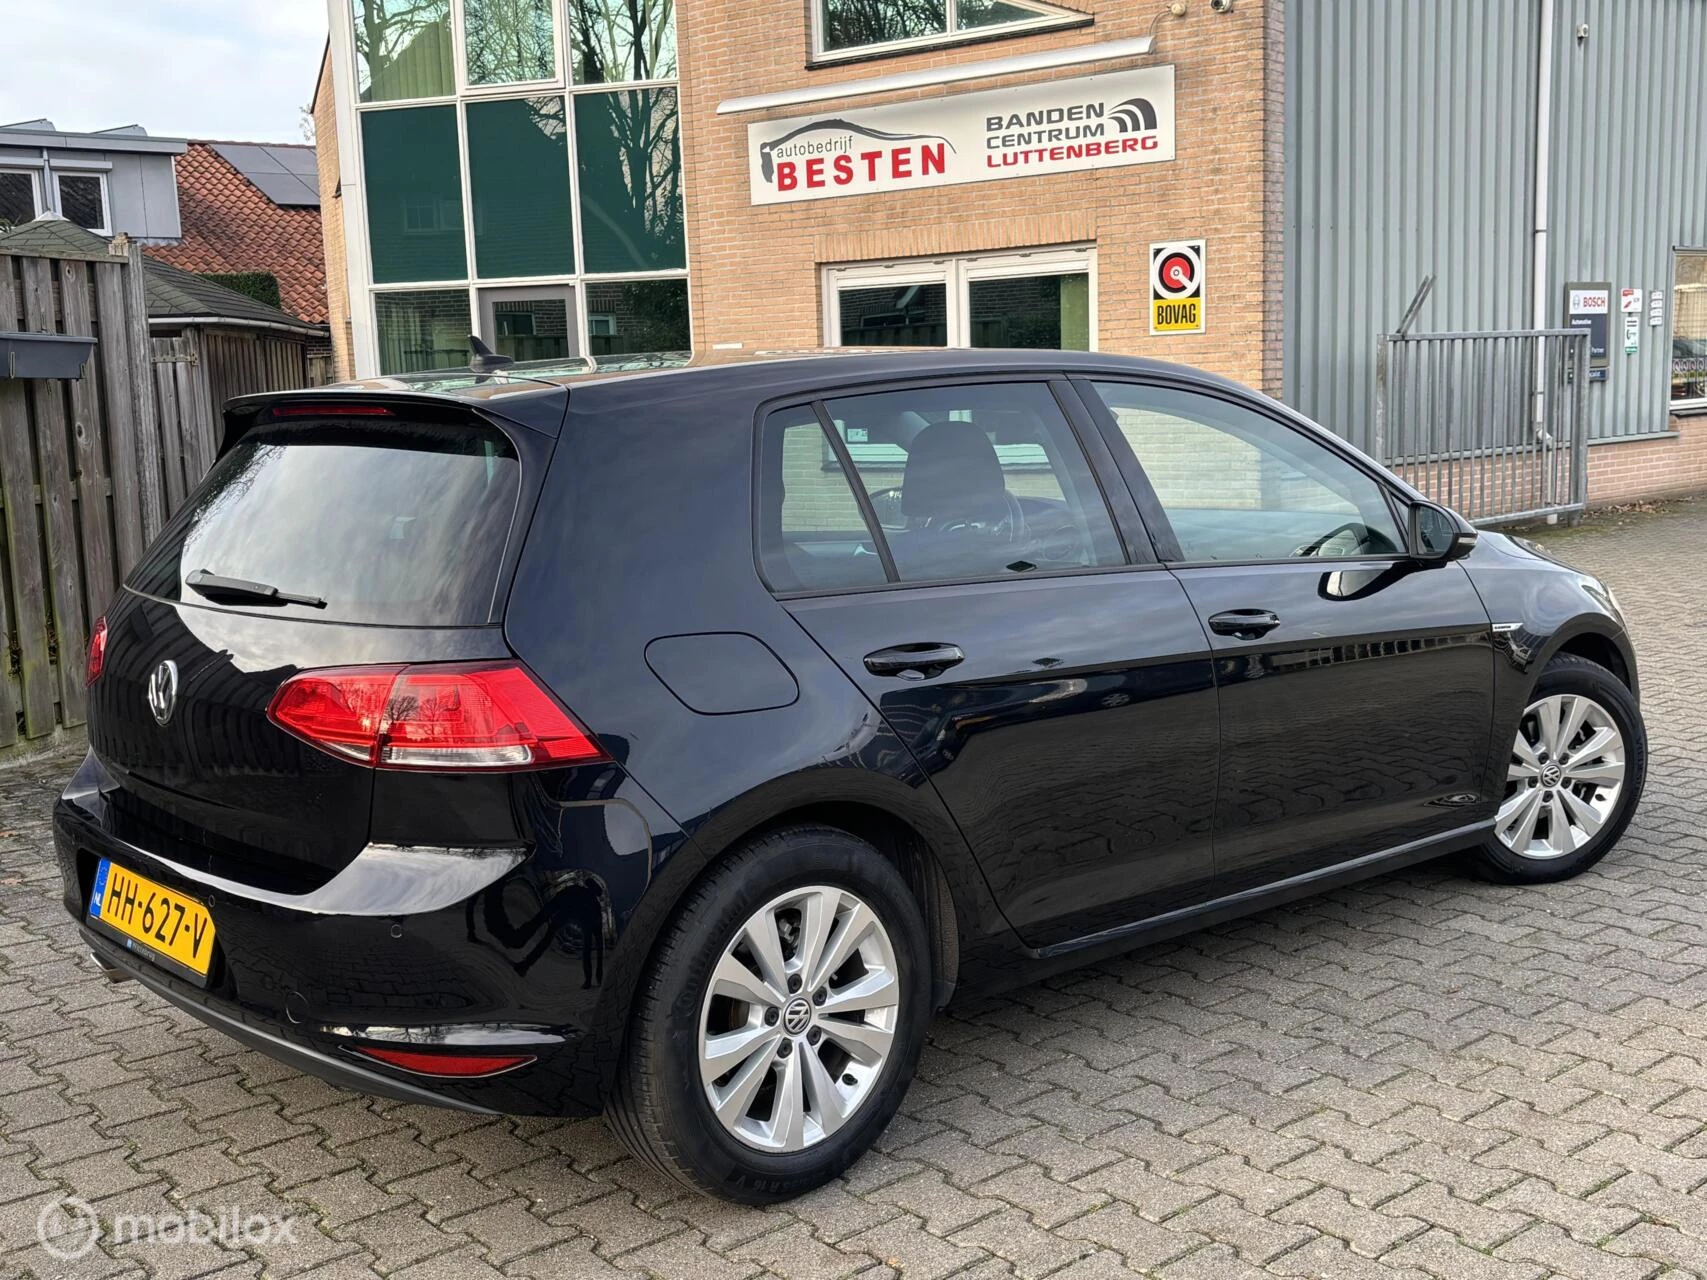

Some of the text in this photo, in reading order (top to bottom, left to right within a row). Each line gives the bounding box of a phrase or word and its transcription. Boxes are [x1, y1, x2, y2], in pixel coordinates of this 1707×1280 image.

[986, 102, 1105, 132] BANDEN
[776, 135, 854, 159] autobedrijf
[986, 123, 1105, 150] CENTRUM
[986, 135, 1159, 168] LUTTENBERG
[776, 143, 946, 192] BESTEN
[1157, 303, 1197, 325] BOVAG
[1583, 296, 1606, 308] BOSCH
[107, 872, 208, 959] HH-627-V
